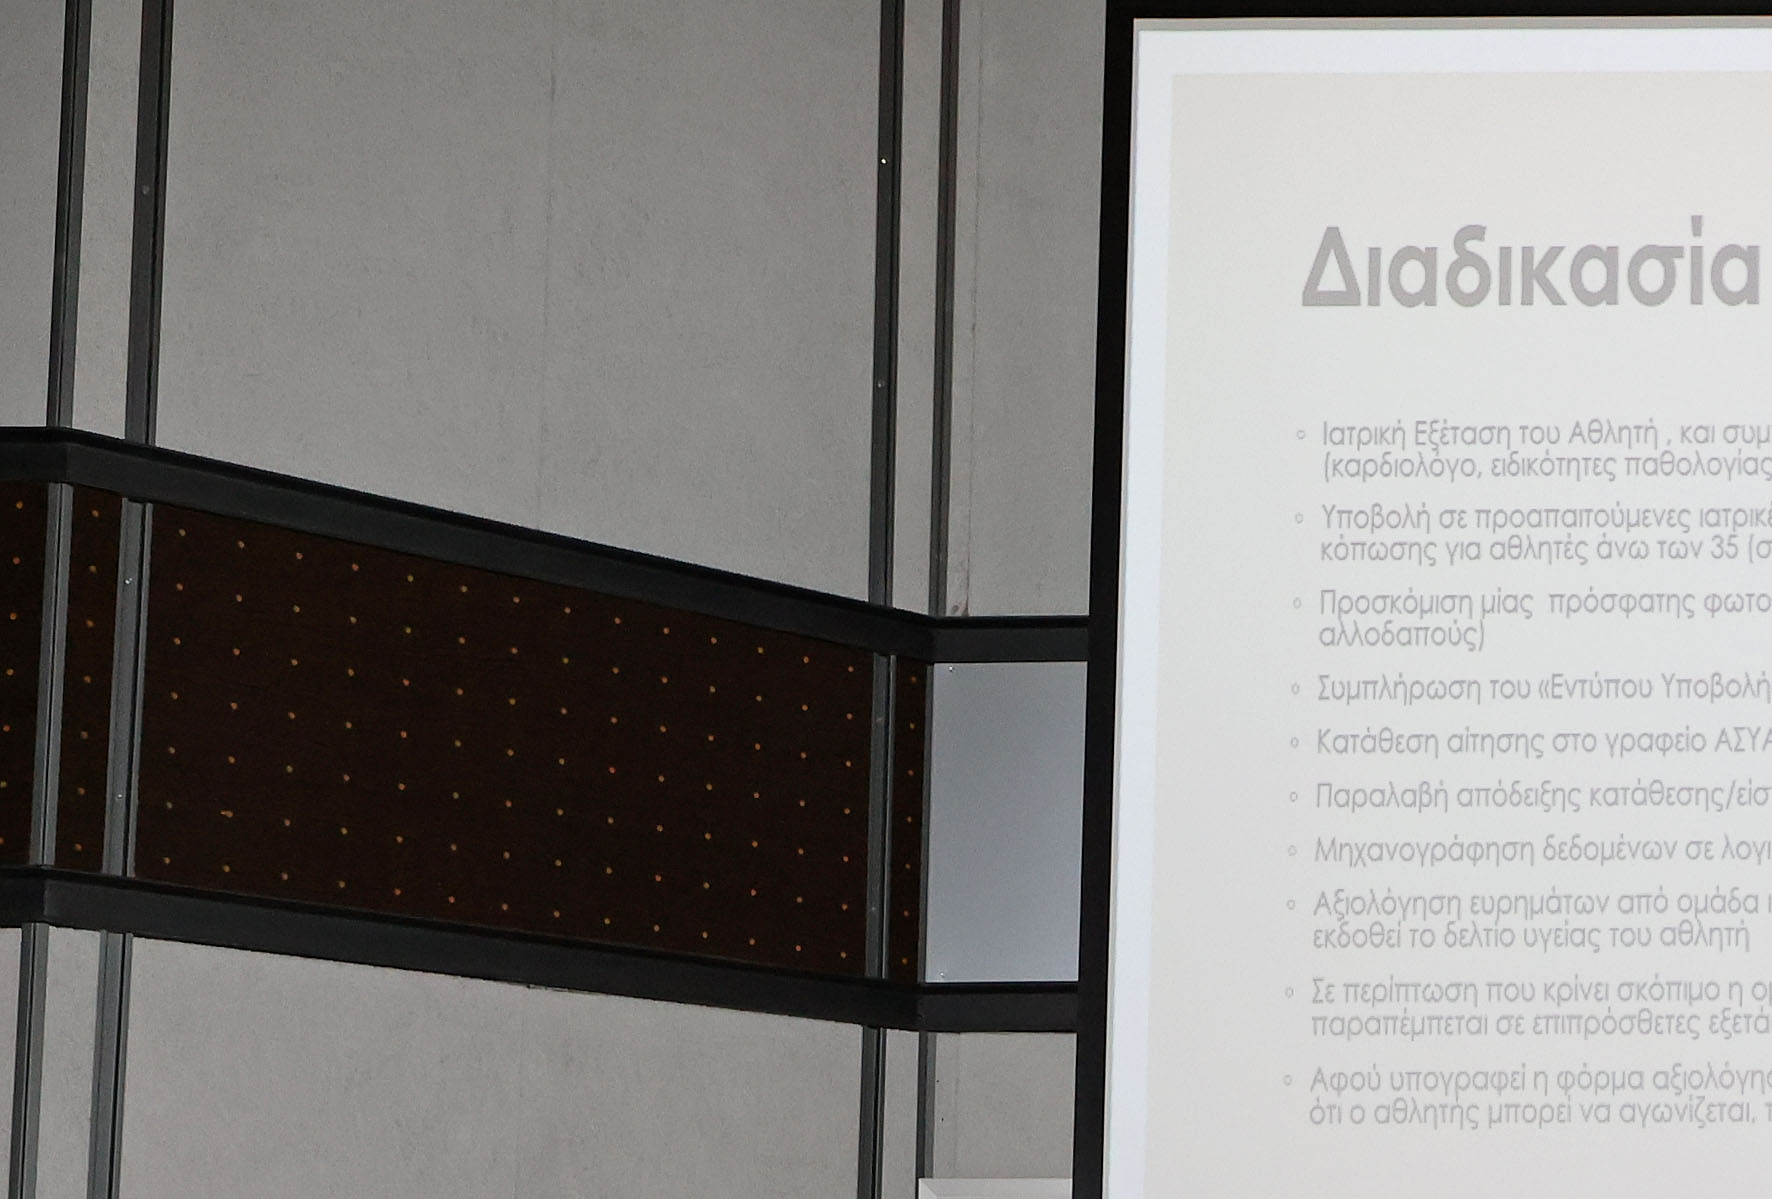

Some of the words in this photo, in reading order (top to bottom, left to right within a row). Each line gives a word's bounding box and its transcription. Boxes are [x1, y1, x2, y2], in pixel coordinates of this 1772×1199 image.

[1301, 215, 1760, 308] Διαδικασία
[1323, 419, 1406, 452] Ιατρική
[1415, 419, 1511, 451] Εξέταση
[1519, 425, 1560, 445] του
[1568, 418, 1658, 450] Αθλητή
[1680, 425, 1715, 444] και
[1491, 449, 1617, 482] ειδικότητες
[1322, 502, 1430, 535] Υποβολή
[1439, 509, 1467, 529] σε
[1474, 501, 1691, 535] προαπαιτούμενες
[1321, 533, 1437, 567] κόπωσης
[1445, 541, 1481, 566] για
[1489, 533, 1588, 566] αθλητές
[1596, 533, 1649, 560] άνω
[1657, 540, 1703, 559] των
[1711, 535, 1739, 559] 35
[1320, 587, 1473, 620] Προσκόμιση
[1480, 587, 1533, 620] μίας
[1548, 586, 1695, 619] πρόσφατης
[1319, 619, 1485, 652] αλλοδαπούς)
[1318, 672, 1481, 706] Συμπλήρωση
[1489, 679, 1531, 699] του
[1318, 726, 1439, 759] Κατάθεση
[1447, 726, 1544, 759] αίτησης
[1552, 733, 1597, 753] στο
[1605, 725, 1707, 758] γραφείο
[1316, 780, 1448, 813] Παραλαβή
[1457, 779, 1581, 813] απόδειξης
[1315, 834, 1534, 867] Μηχανογράφηση
[1543, 833, 1677, 866] δεδομένων
[1685, 840, 1714, 861] σε
[1313, 888, 1461, 922] Αξιολόγηση
[1470, 886, 1610, 921] ευρημάτων
[1618, 885, 1668, 914] από
[1677, 886, 1759, 921] ομάδα
[1313, 920, 1401, 949] εκδοθεί
[1409, 929, 1436, 948] το
[1444, 920, 1515, 948] δελτίο
[1524, 920, 1601, 953] υγείας
[1609, 927, 1652, 947] του
[1660, 920, 1749, 952] αθλητή
[1312, 977, 1335, 1002] Σε
[1343, 975, 1478, 1009] περίπτωση
[1486, 982, 1535, 1002] που
[1544, 974, 1609, 1009] κρίνει
[1617, 973, 1720, 1008] σκόπιμο
[1728, 981, 1743, 1008] η
[1312, 1008, 1488, 1041] παραπέμπεται
[1496, 1015, 1525, 1035] σε
[1533, 1007, 1700, 1040] επιπρόσθετες
[1310, 1064, 1381, 1098] Αφού
[1390, 1063, 1526, 1097] υπογραφεί
[1534, 1071, 1548, 1096] η
[1557, 1063, 1644, 1097] φόρμα
[1309, 1096, 1342, 1125] ότι
[1350, 1104, 1365, 1124] ο
[1374, 1096, 1479, 1130] αθλητής
[1488, 1095, 1571, 1129] μπορεί
[1580, 1103, 1610, 1123] να
